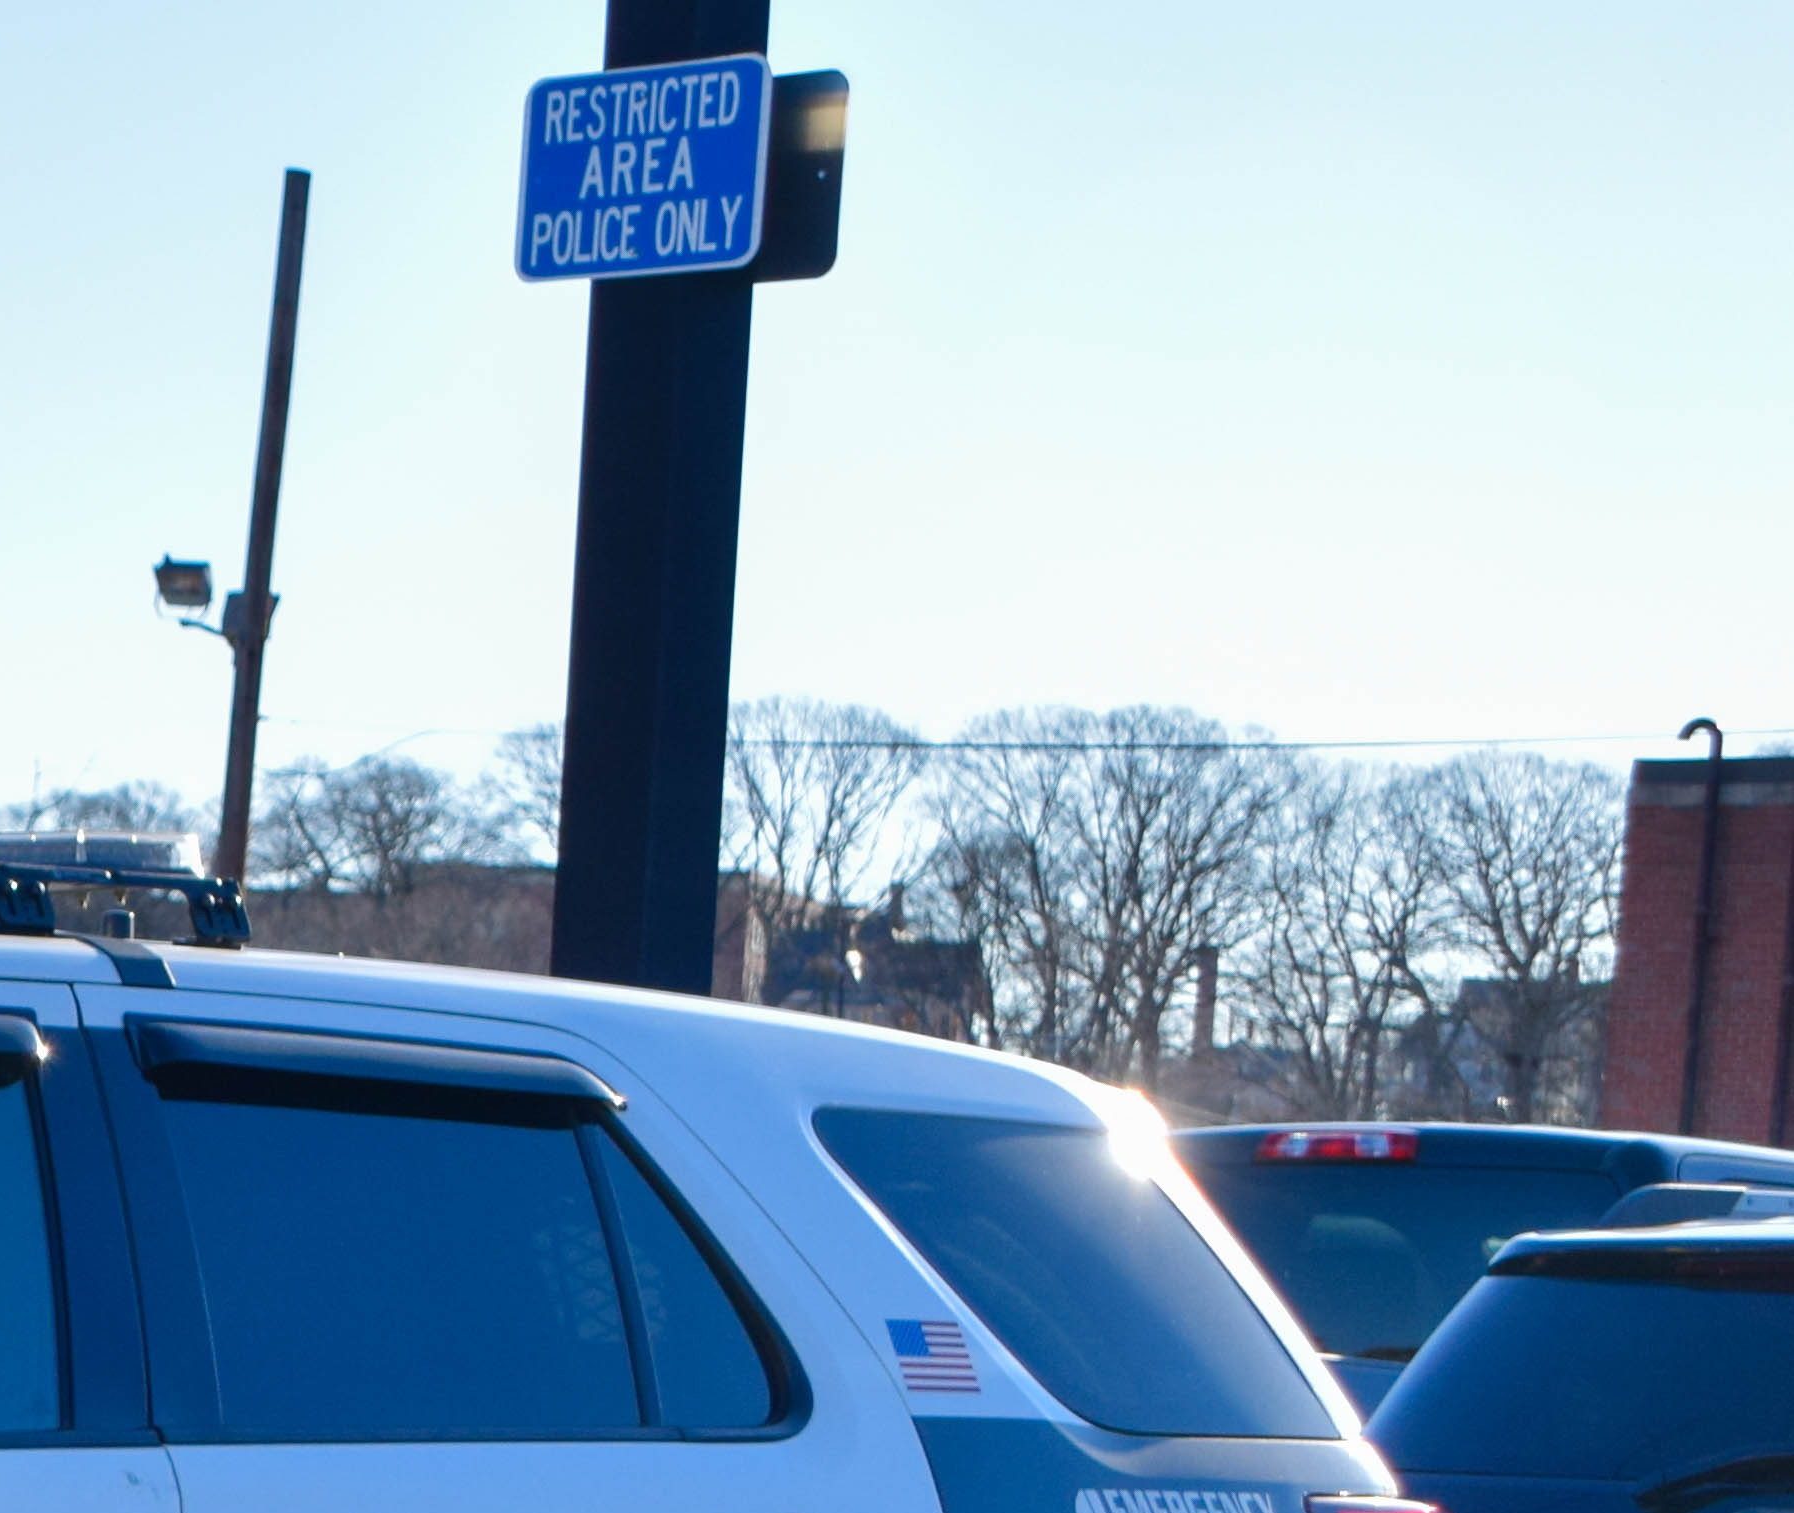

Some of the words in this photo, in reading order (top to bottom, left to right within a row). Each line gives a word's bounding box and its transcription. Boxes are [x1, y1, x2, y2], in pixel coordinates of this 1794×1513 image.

[544, 71, 740, 145] RESTRICTED
[579, 136, 694, 200] AREA
[530, 204, 642, 267] POLICE
[655, 195, 743, 256] ONLY
